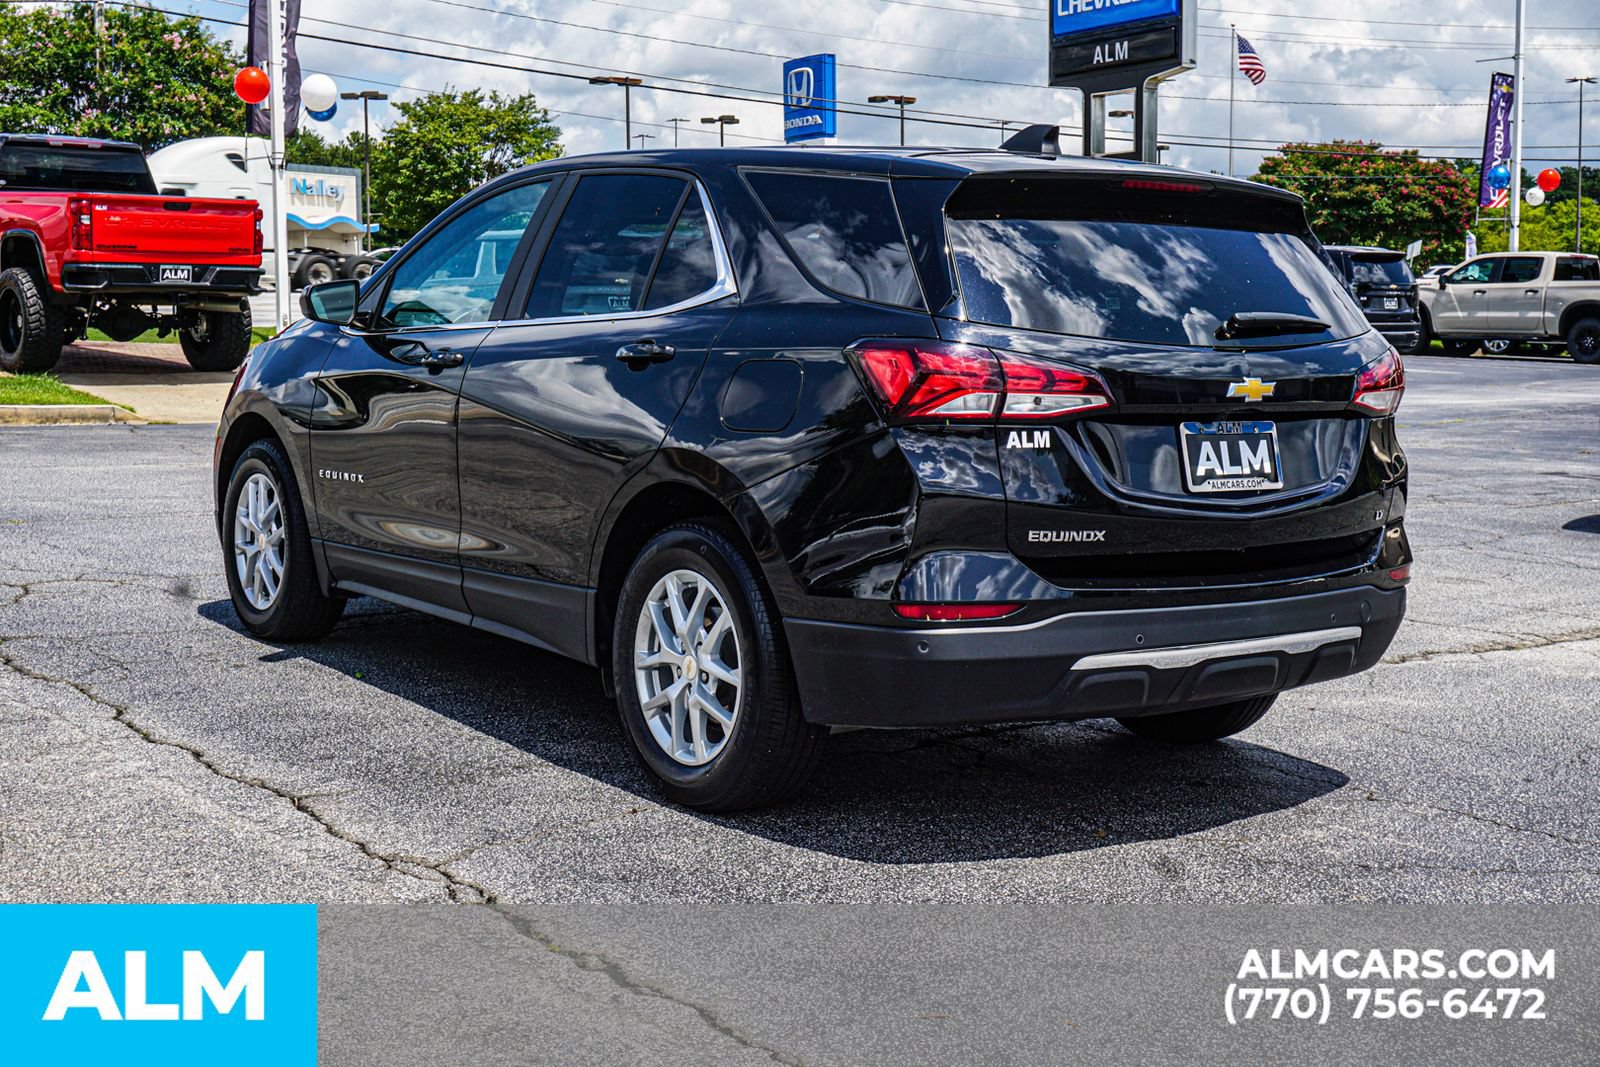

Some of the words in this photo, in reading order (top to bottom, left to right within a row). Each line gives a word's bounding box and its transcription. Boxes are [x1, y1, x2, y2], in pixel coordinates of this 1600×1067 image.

[1093, 41, 1129, 64] ALM
[784, 114, 823, 130] HONDA
[291, 177, 346, 200] Nalley
[163, 269, 189, 280] ALM
[1217, 422, 1241, 434] ALM
[1006, 430, 1051, 449] ALM
[1196, 439, 1272, 477] ALM
[319, 469, 365, 484] EQUINOX
[1027, 529, 1107, 543] EQUINOX
